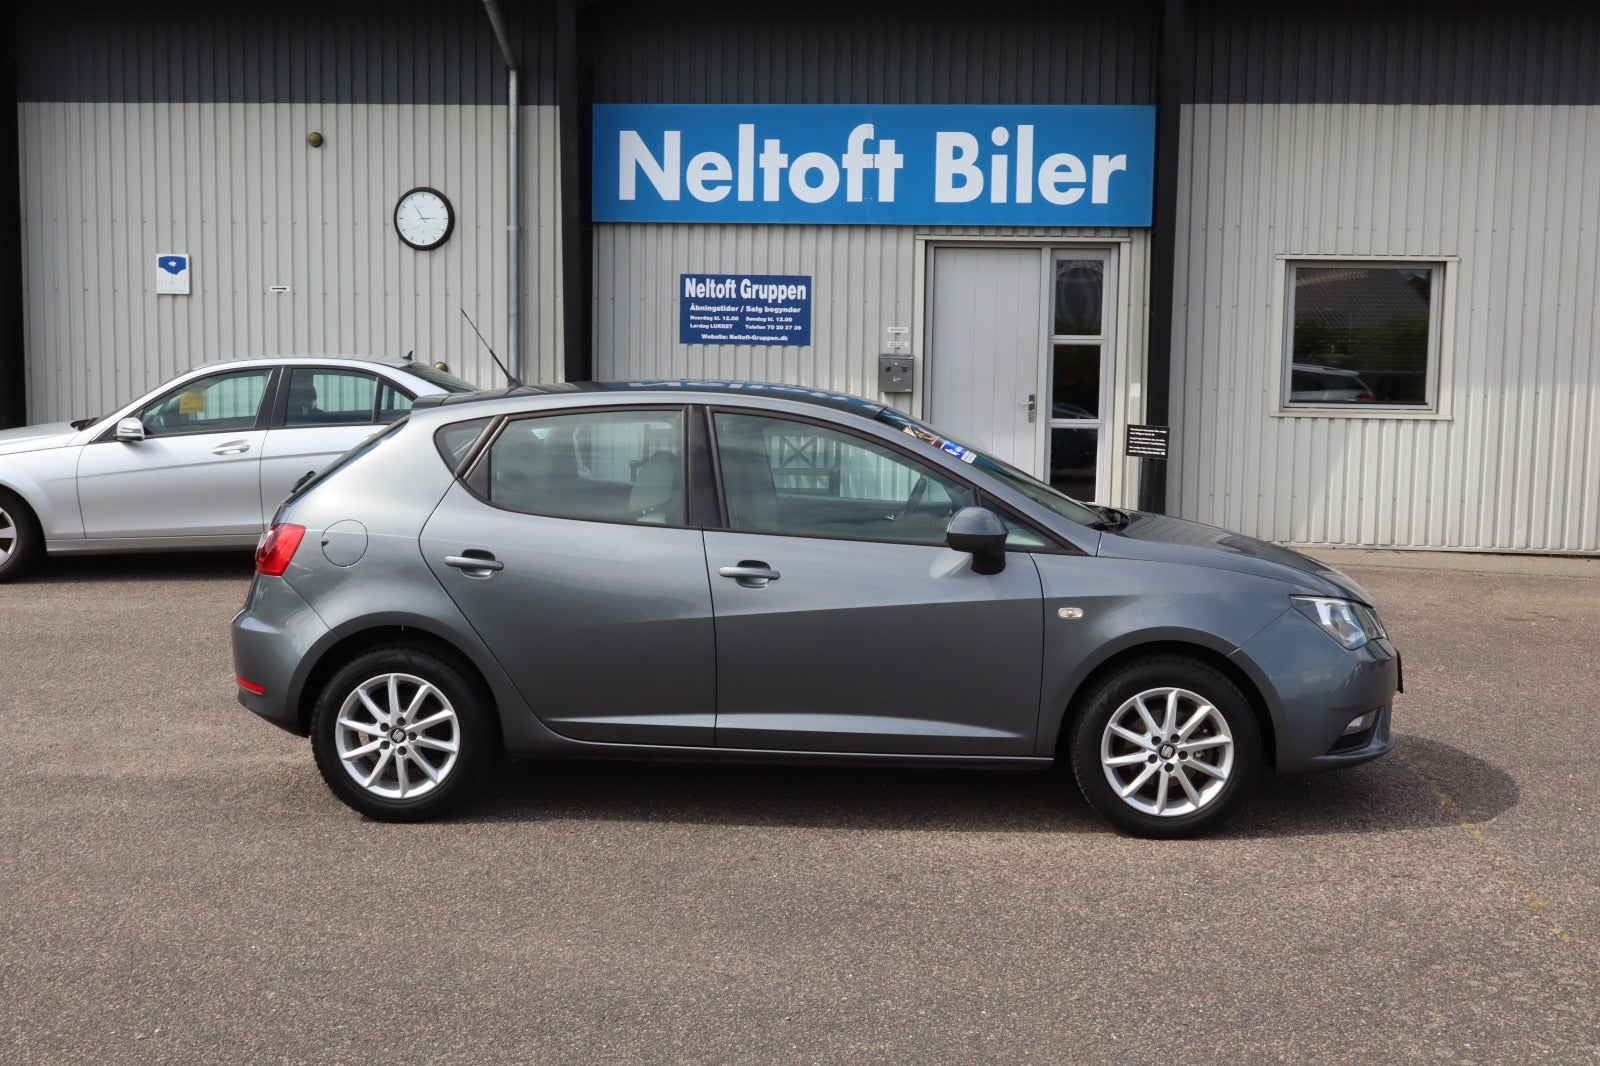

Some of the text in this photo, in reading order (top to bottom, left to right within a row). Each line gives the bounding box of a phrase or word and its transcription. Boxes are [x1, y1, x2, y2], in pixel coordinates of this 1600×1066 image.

[619, 123, 1127, 205] Neltoft Biler
[685, 278, 807, 304] Neltoft Gruppen
[690, 303, 739, 313] Åbningstider
[745, 305, 763, 313] Salg
[764, 305, 801, 313] begynder
[729, 334, 789, 342] Neltoft-Gruppen.dk
